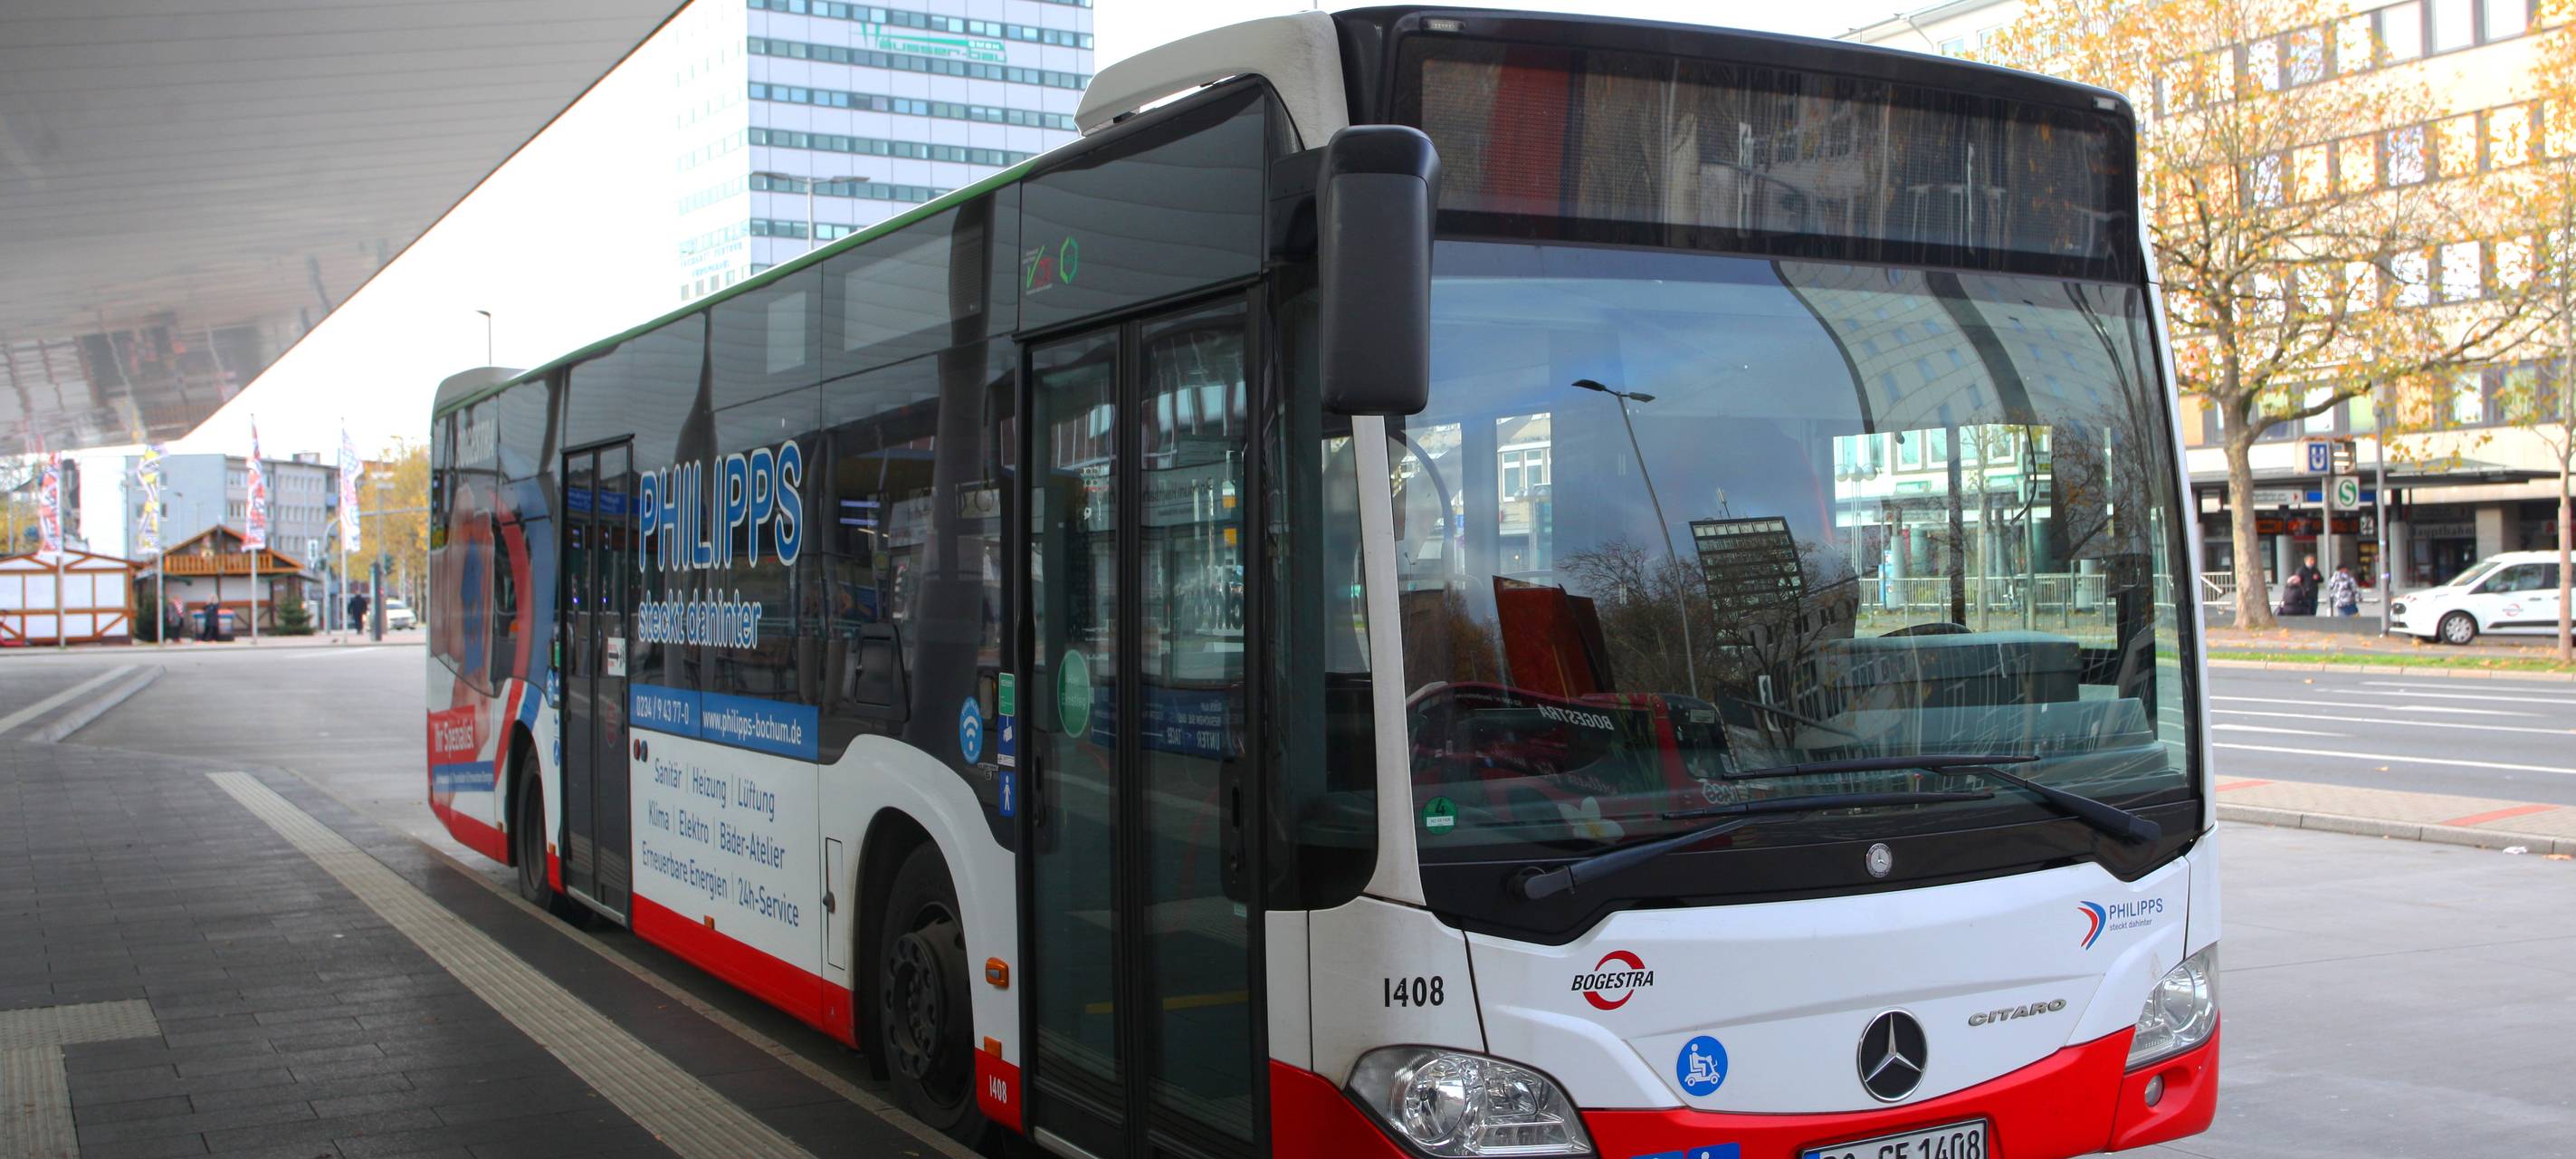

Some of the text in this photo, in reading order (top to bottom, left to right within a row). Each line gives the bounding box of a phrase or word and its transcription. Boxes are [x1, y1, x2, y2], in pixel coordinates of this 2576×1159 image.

[2311, 445, 2325, 470] U
[638, 439, 803, 573] PHILIPPS
[2340, 480, 2356, 507] S
[638, 589, 762, 650] steckt dahinter
[636, 695, 652, 718] 0234
[663, 700, 672, 723] 43
[673, 701, 690, 724] 77-0
[702, 708, 802, 745] www.philipps-bochum.de
[654, 758, 775, 822] Sanitär Heizung Lüftung
[1435, 798, 1446, 816] 4
[648, 800, 786, 870] Klima Elektro Bäder-Atelier
[642, 840, 799, 927] Erneuerbare Energien 24h-Service
[2109, 897, 2163, 920] PHILIPPS
[2109, 918, 2152, 932] steckt dahinter
[1384, 975, 1445, 1008] 1408
[1570, 971, 1655, 991] BOGESTRA
[1968, 999, 2067, 1027] CITARO
[989, 1074, 1007, 1104] 1408
[1918, 1130, 1980, 1159] 1408
